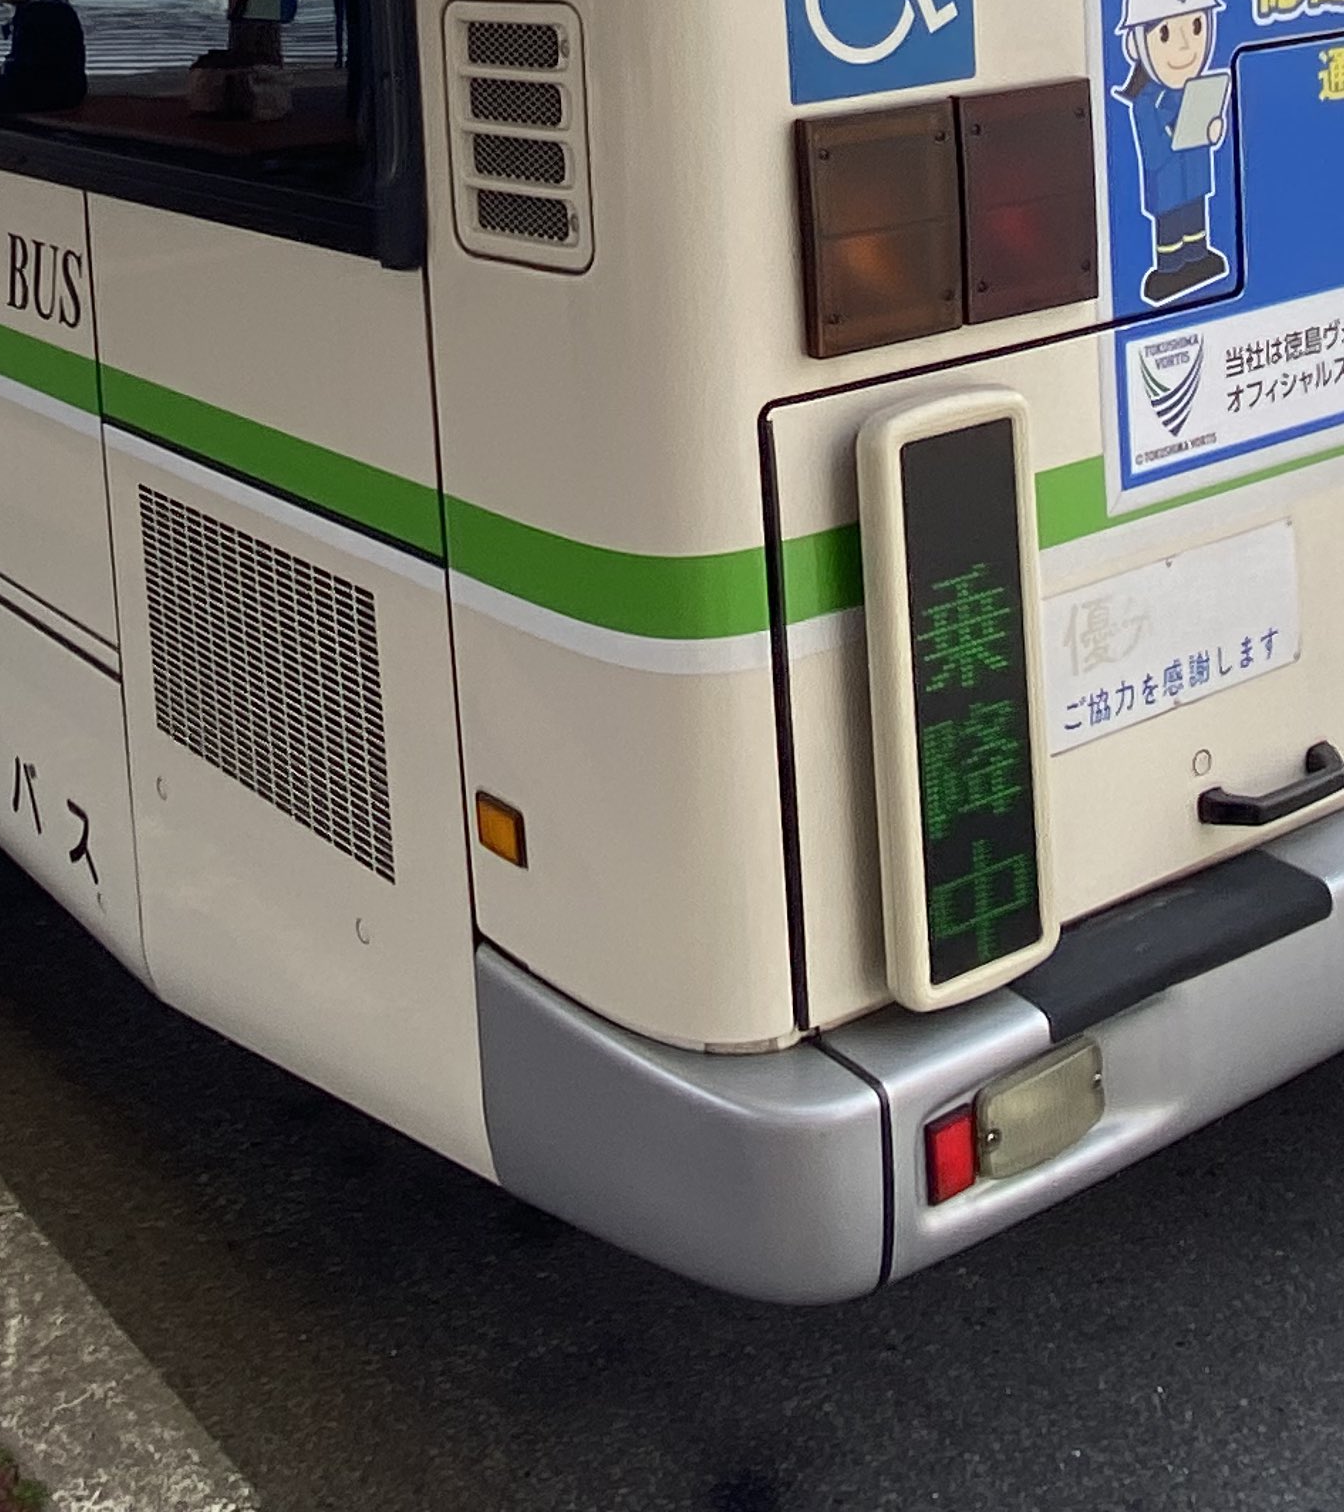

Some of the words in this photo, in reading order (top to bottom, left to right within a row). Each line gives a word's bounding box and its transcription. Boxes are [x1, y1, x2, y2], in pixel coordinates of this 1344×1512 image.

[7, 233, 83, 330] BUS
[1064, 627, 1279, 731] ご協力を感謝します
[916, 561, 1033, 963] 乗降中
